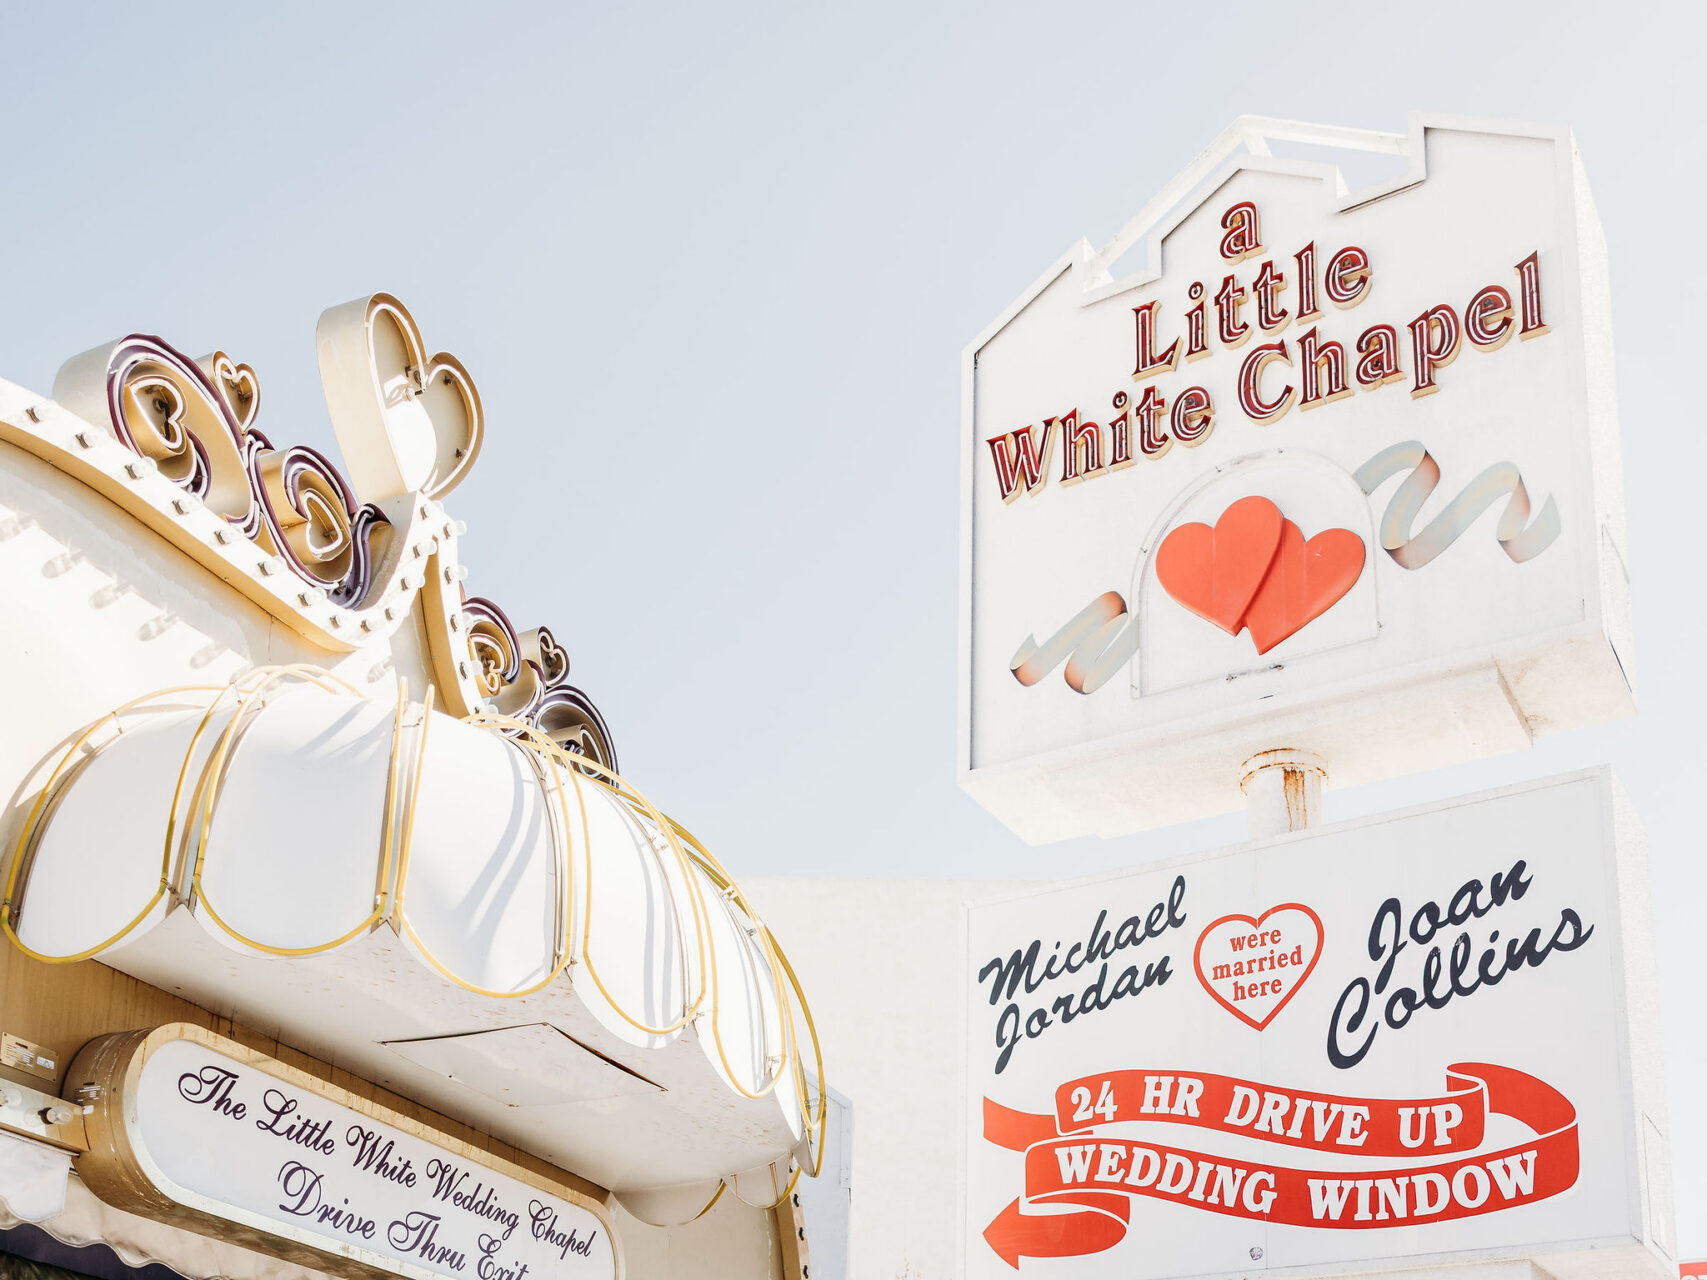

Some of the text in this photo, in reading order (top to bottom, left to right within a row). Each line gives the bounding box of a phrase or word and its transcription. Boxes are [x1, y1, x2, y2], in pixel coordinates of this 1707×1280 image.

[1220, 200, 1267, 265] a
[1131, 240, 1372, 380] Little
[986, 250, 1551, 505] White Chapel
[978, 875, 1188, 1006] Michael
[1211, 945, 1303, 981] married
[1229, 926, 1282, 953] were
[1367, 859, 1534, 994] Joan
[995, 955, 1175, 1074] Jordan
[1232, 975, 1283, 1003] here
[1326, 907, 1595, 1070] Collins
[177, 1065, 598, 1260] The Little White Wedding Chapel
[1070, 1075, 1464, 1149] 24 HR DRIVE UP
[277, 1160, 376, 1240] Drive
[387, 1209, 467, 1272] Thru
[1053, 1144, 1542, 1222] WEDDING WINDOW
